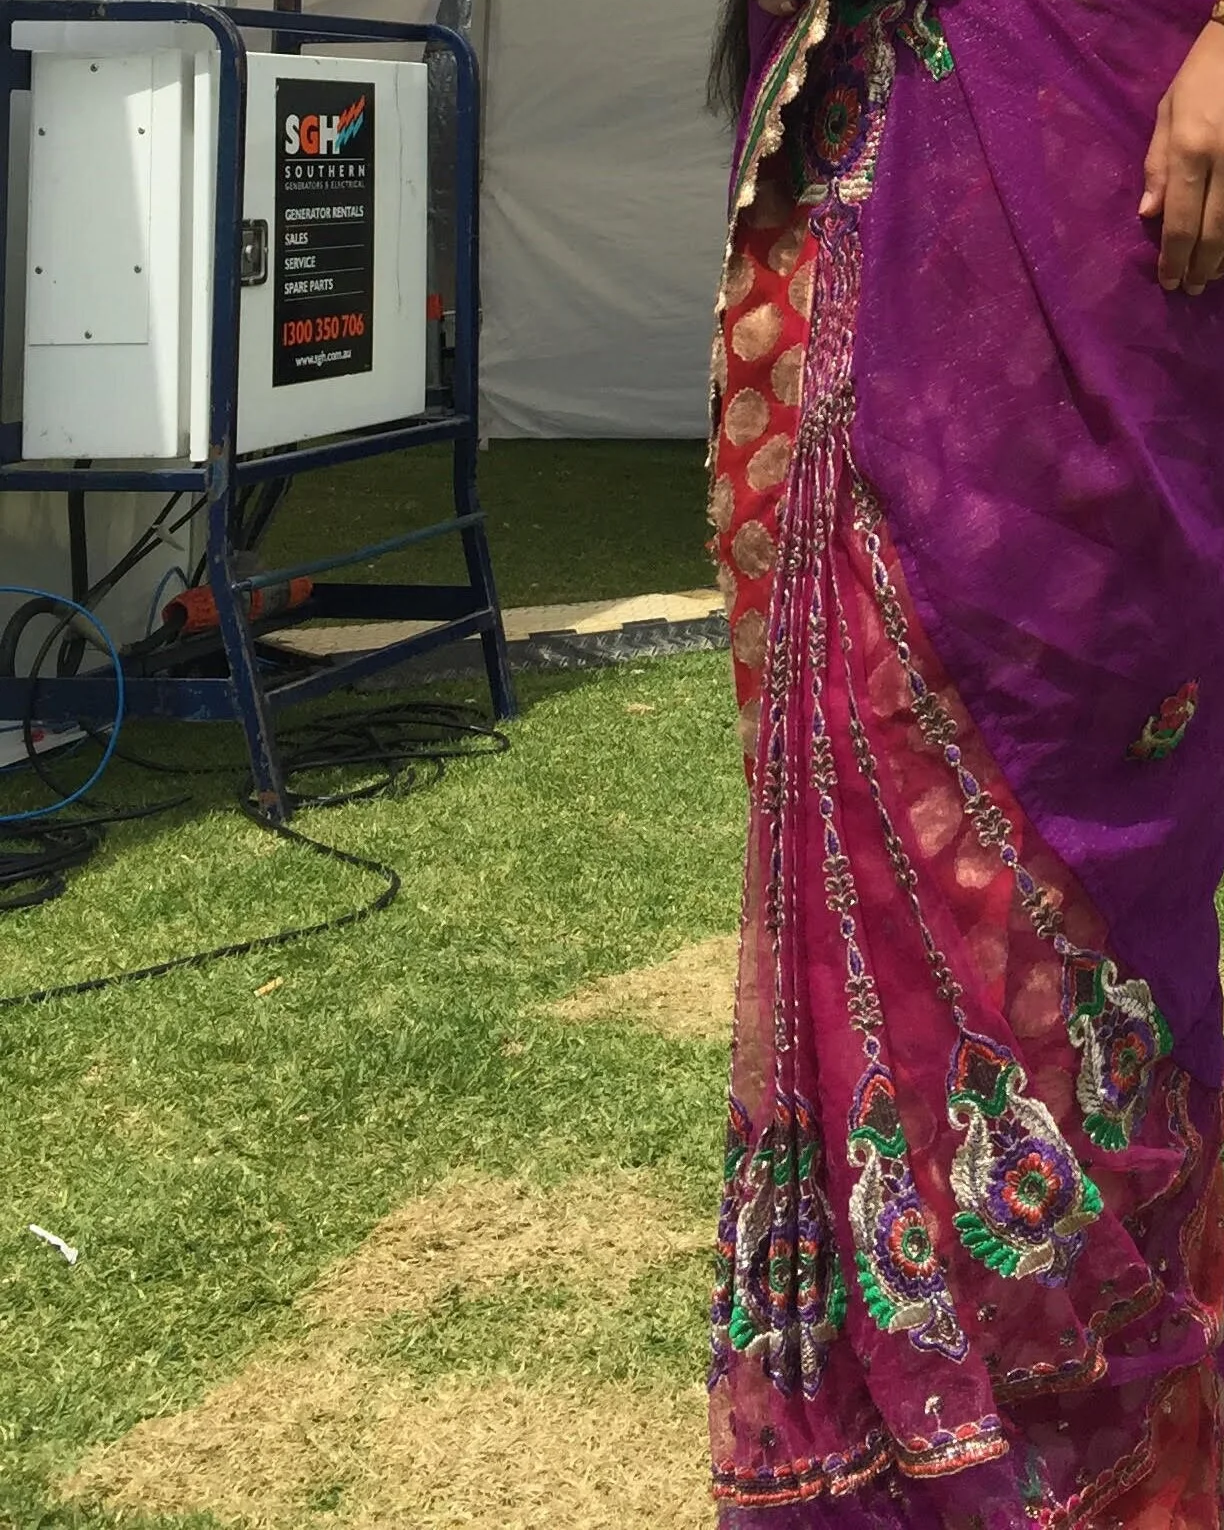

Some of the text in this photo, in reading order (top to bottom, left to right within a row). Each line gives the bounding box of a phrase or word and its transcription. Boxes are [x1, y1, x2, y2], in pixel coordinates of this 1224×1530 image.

[285, 114, 340, 155] SGH
[284, 165, 366, 179] SOUTHERN
[284, 205, 364, 221] GENERATOR RENTALS
[284, 232, 309, 246] SALES
[284, 255, 316, 271] SERVICE
[284, 277, 334, 295] SPARE PARTS
[283, 313, 365, 347] 1300 350 706
[295, 349, 352, 367] www.sgh.com.au
